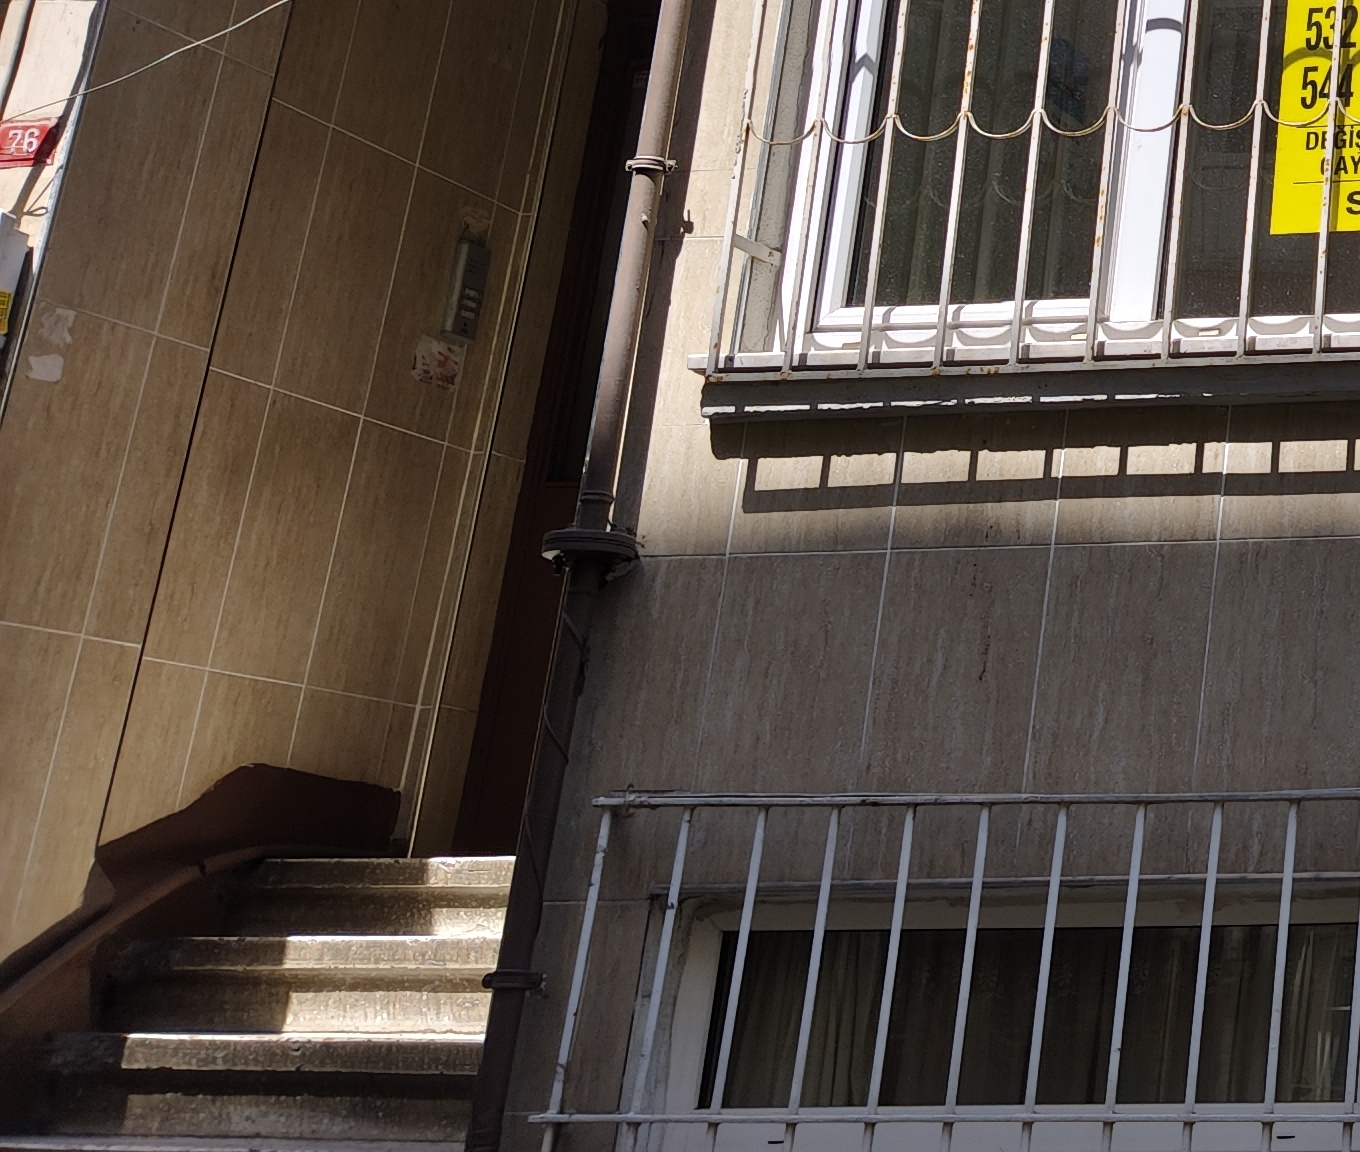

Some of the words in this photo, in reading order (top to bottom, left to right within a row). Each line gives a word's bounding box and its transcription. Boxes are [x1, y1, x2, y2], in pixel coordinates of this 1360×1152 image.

[1305, 5, 1358, 51] 532
[1300, 64, 1353, 109] 544
[9, 127, 40, 154] 76
